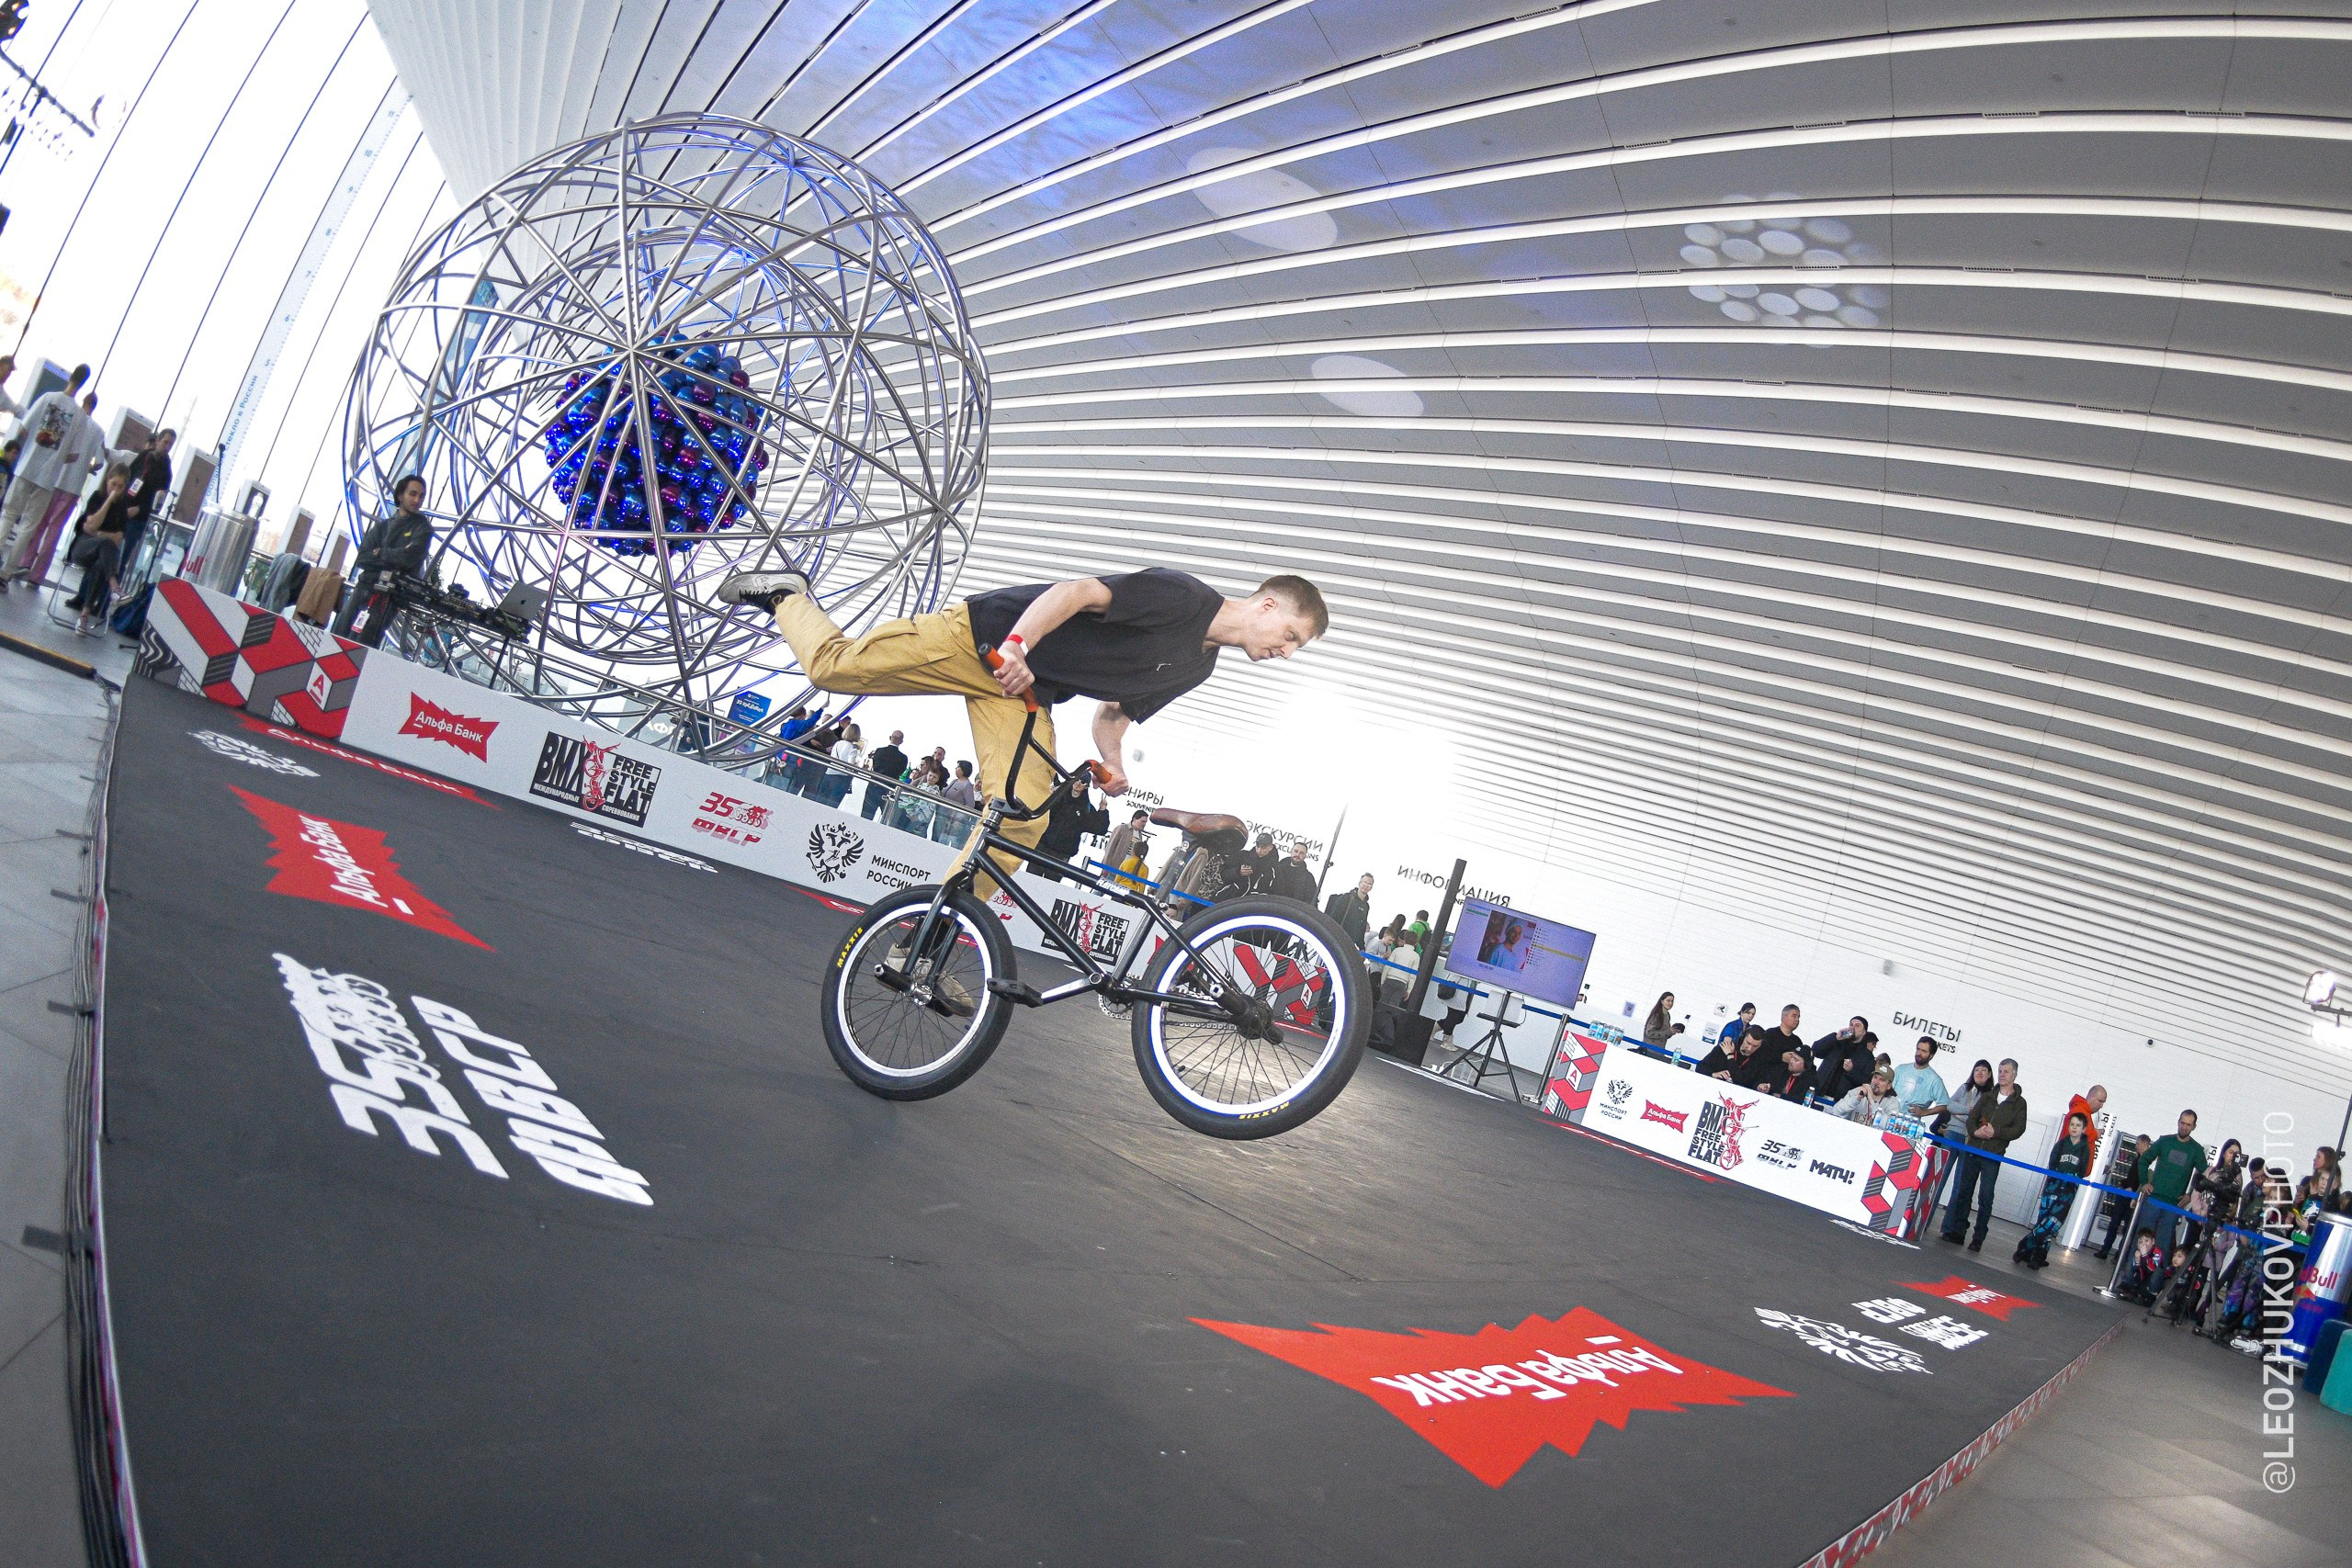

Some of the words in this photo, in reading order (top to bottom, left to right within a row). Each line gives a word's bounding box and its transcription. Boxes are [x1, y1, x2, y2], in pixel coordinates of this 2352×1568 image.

[240, 375, 258, 409] России
[414, 710, 453, 734] Альфа
[455, 724, 483, 743] Банк
[536, 736, 591, 795] BMX
[612, 755, 653, 779] FREE
[533, 783, 580, 803] МЕЖДУНАРОДНЫЕ
[608, 772, 655, 795] STYLE
[605, 783, 654, 814] FLAT
[699, 791, 742, 818] 35
[602, 805, 640, 822] СОРЕВНОВАНИЯ
[299, 814, 349, 853] Банк
[1246, 820, 1324, 852] ЭКСКУРСИИ
[312, 848, 389, 908] Альфа
[871, 854, 931, 882] МИНСПОРТ
[1094, 924, 1125, 940] STYLE
[1097, 913, 1125, 930] FREE
[837, 927, 863, 968] MAXXIS
[1091, 933, 1123, 954] FLAT
[1893, 1011, 1962, 1043] БИЛЕТЫ
[1238, 1100, 1290, 1120] MAXXIS
[1600, 1102, 1628, 1115] МИНСПОРТ
[1601, 1111, 1623, 1121] РОССИИ
[1647, 1107, 1667, 1120] Альфа
[1667, 1114, 1681, 1125] Банк
[1692, 1136, 1724, 1152] STYLE
[1695, 1128, 1722, 1143] FREE
[1761, 1139, 1785, 1154] 35
[1688, 1145, 1720, 1166] FLAT
[1809, 1159, 1855, 1185] МАТЧ!
[2307, 1267, 2338, 1290] Bull
[1517, 1346, 1684, 1387] Альфа
[1370, 1364, 1566, 1406] Банк
